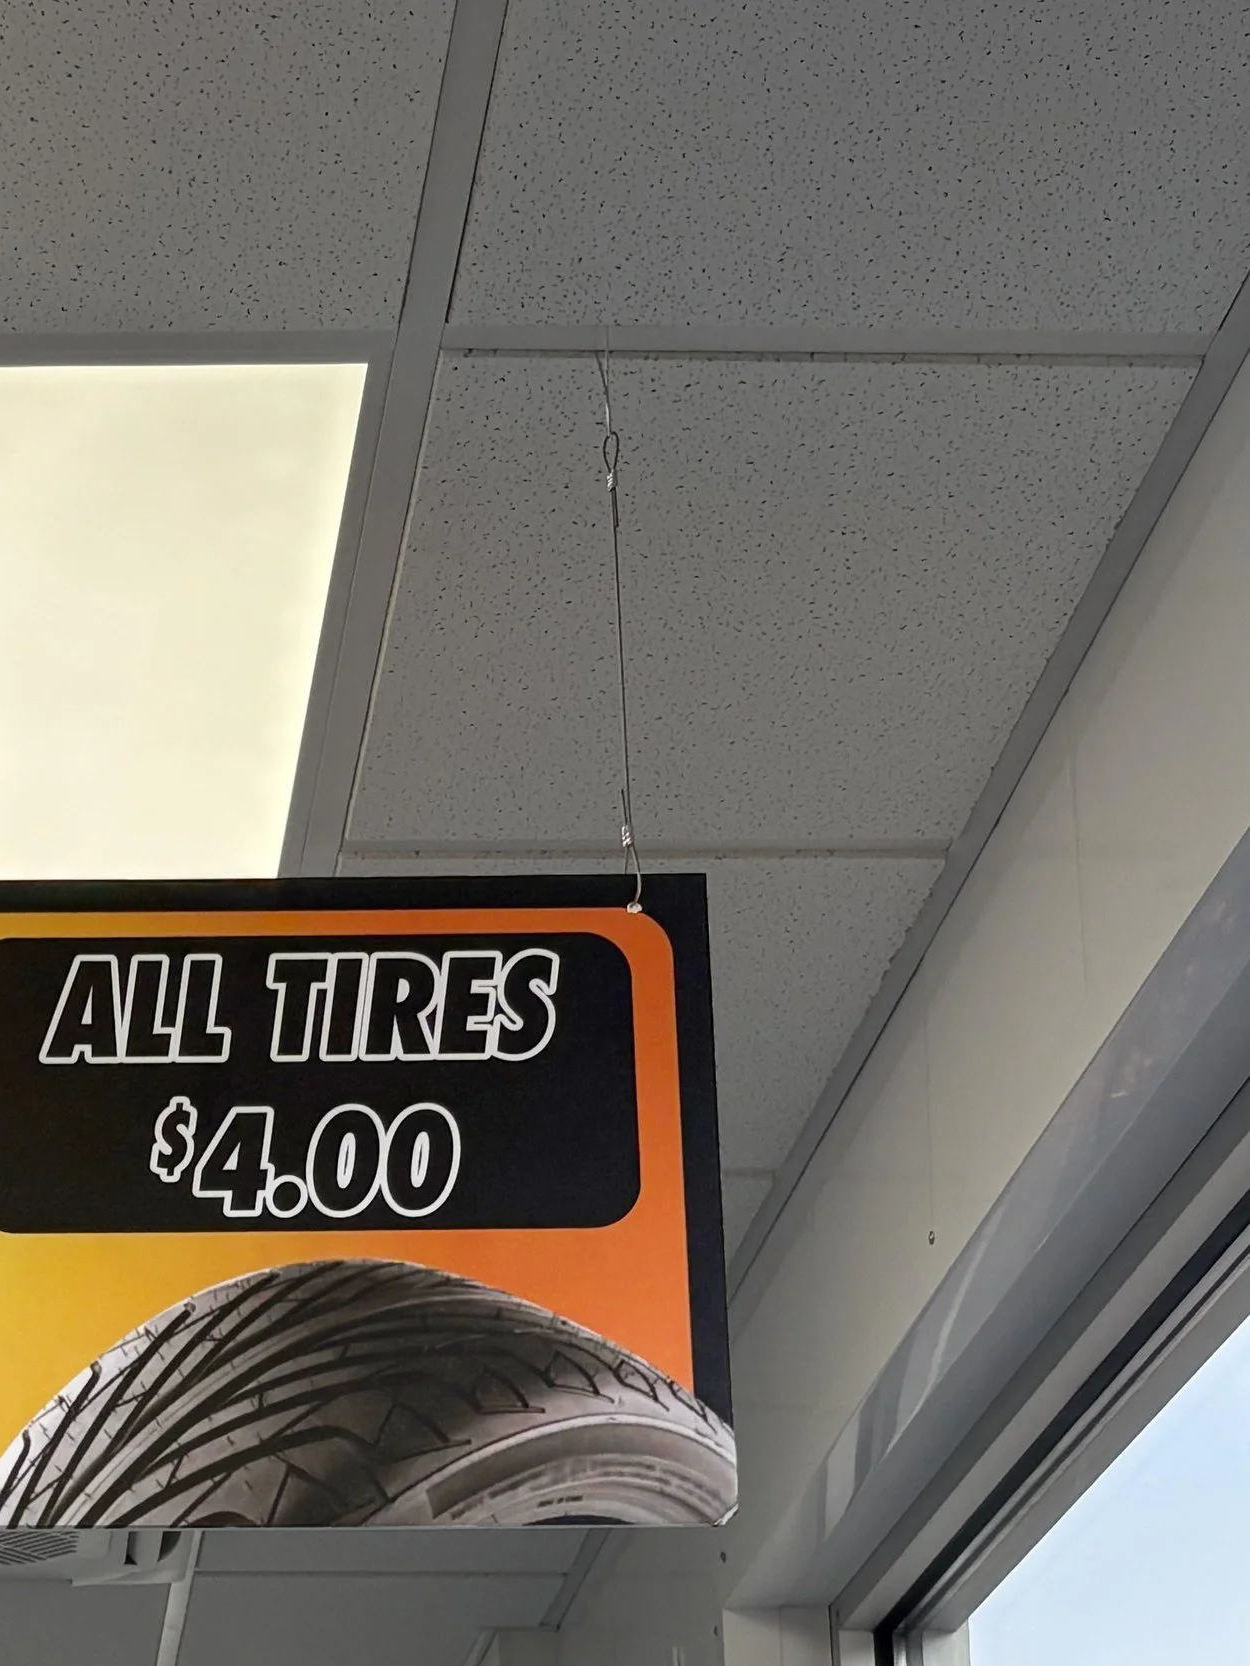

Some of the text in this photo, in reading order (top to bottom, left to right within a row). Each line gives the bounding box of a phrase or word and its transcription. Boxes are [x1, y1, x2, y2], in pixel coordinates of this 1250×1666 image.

[38, 949, 560, 1065] ALL TIRES
[150, 1096, 461, 1218] $4.00
